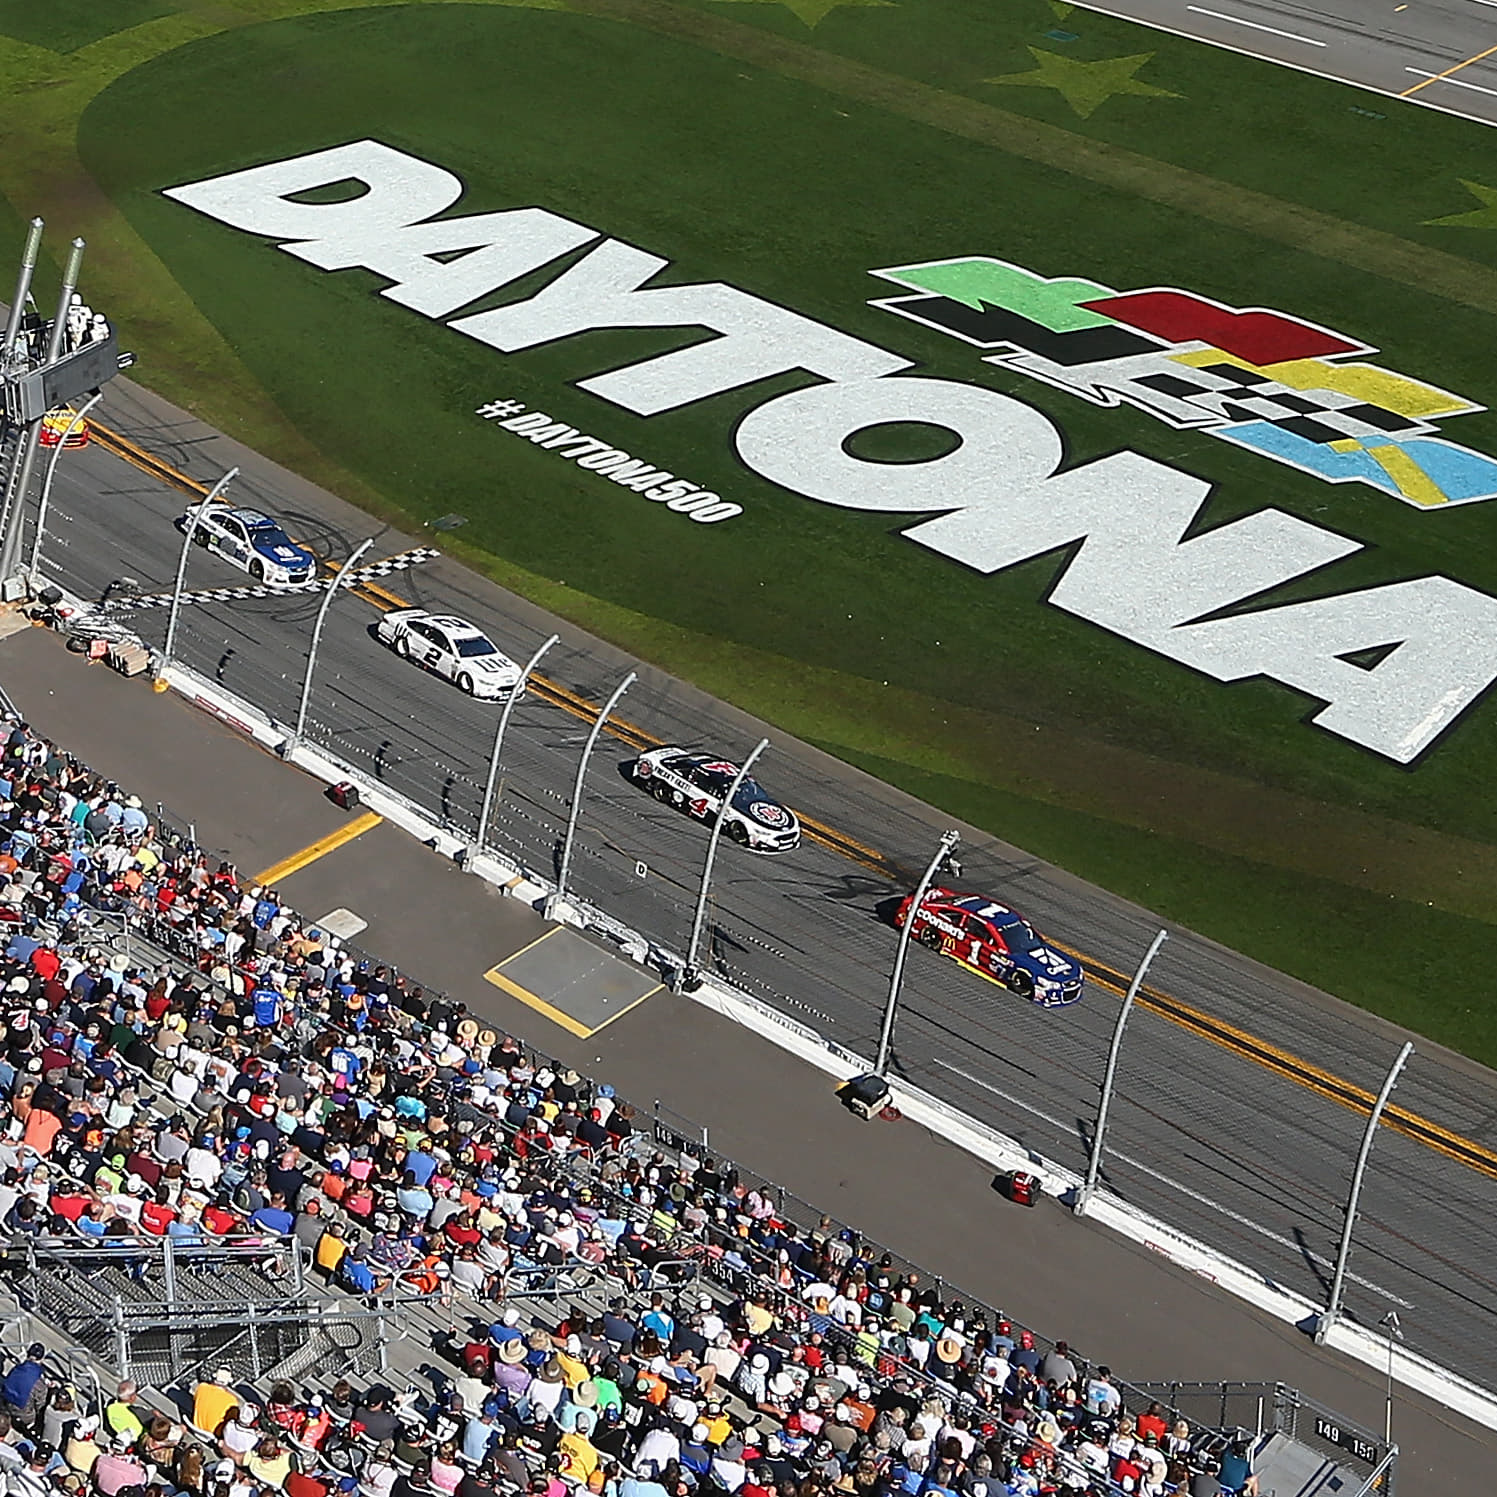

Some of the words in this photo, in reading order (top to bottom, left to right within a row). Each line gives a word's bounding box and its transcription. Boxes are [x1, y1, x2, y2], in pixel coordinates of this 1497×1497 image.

[475, 396, 745, 525] #DAYTONA500
[423, 647, 443, 668] 2
[688, 798, 710, 819] 4
[909, 905, 966, 941] cDonald's
[966, 940, 983, 966] 1
[1317, 1420, 1340, 1442] 149
